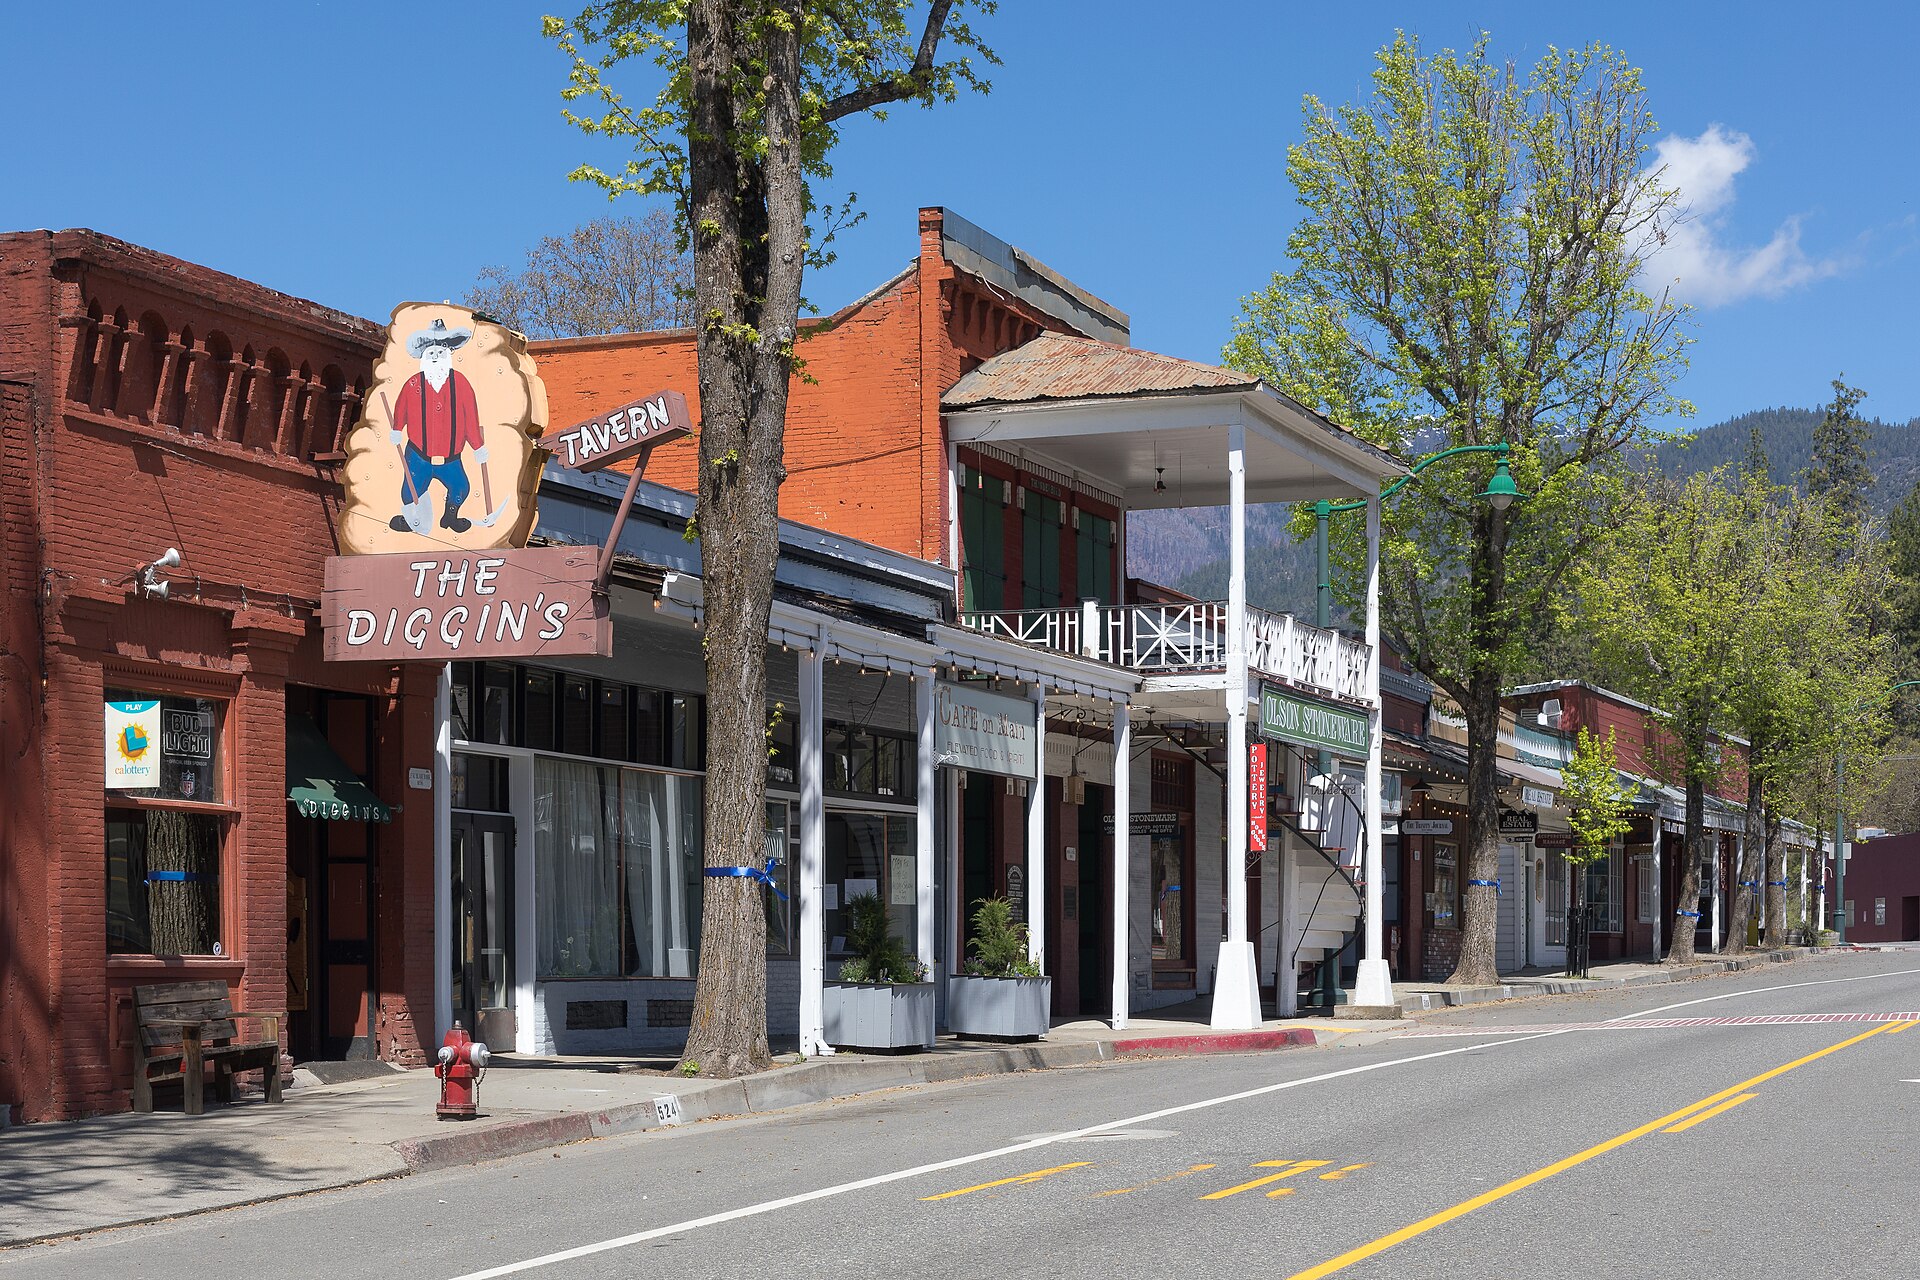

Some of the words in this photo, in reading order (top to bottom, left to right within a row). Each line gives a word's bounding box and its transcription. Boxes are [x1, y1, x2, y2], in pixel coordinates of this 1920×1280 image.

[559, 395, 670, 466] TAVERN
[410, 558, 506, 598] THE
[347, 592, 570, 650] DIGGIN'S
[125, 703, 143, 712] PLAY
[940, 685, 978, 732] CAFE
[982, 718, 994, 735] on
[997, 712, 1026, 741] Main
[171, 713, 203, 735] BUD
[1265, 696, 1300, 732] OLSON
[1303, 706, 1366, 746] STONEWARE
[166, 731, 209, 753] LIGHT
[947, 741, 978, 757] ELEVATED
[115, 764, 151, 777] calottery
[1537, 790, 1552, 805] ESTATE
[1103, 815, 1115, 823] OLS
[1130, 813, 1176, 822] STONEWARE
[1251, 820, 1266, 839] HOME
[657, 1103, 677, 1120] 524
